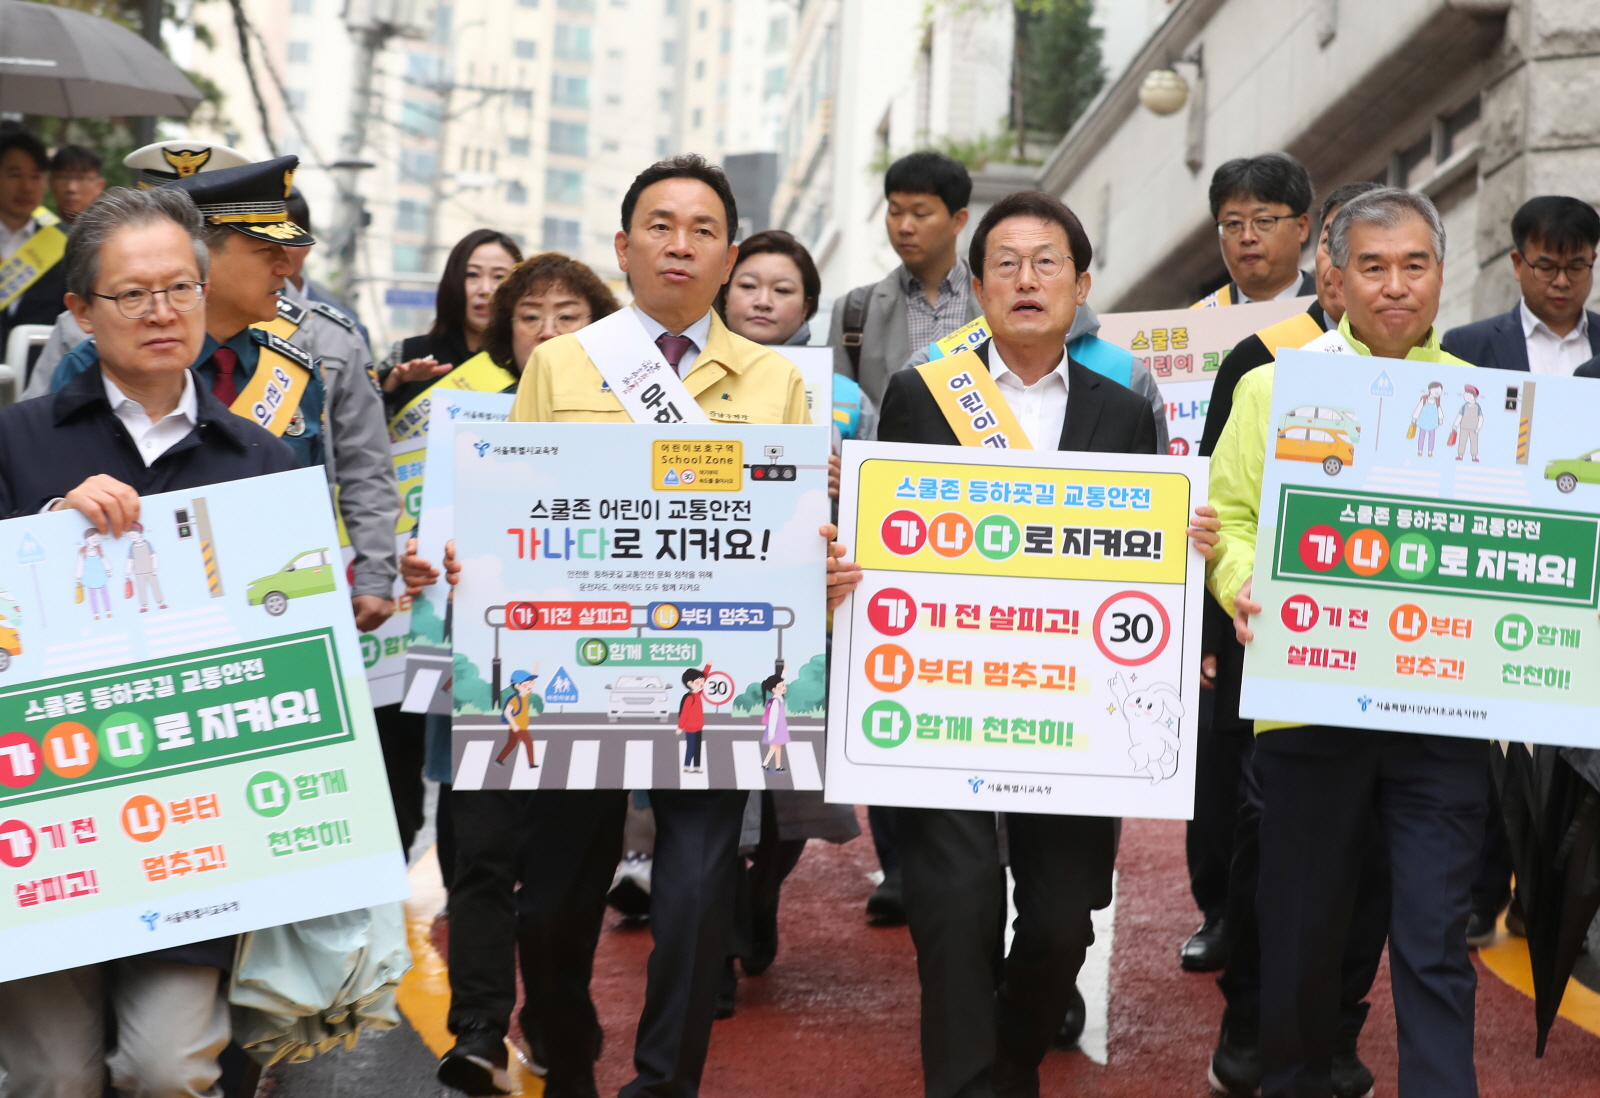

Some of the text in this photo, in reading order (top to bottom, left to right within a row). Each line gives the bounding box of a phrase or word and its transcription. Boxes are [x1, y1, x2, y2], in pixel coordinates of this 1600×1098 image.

[1131, 327, 1189, 351] 스쿨존
[1202, 350, 1234, 371] 교
[256, 369, 290, 426] 어린이
[492, 446, 559, 456] 서울특별시교육청
[661, 443, 734, 453] 어린이보호구역
[661, 455, 734, 464] School Zone
[896, 477, 1151, 509] 스쿨존 등하굣길 교통안전
[530, 499, 752, 522] 스쿨존 어린이 교통안전
[1339, 505, 1541, 541] 스쿨존 등하굣길 교통안전
[507, 527, 771, 561] 가나다로 지켜요!
[1062, 527, 1162, 560] 지켜요!
[625, 570, 655, 579] 교통안전
[698, 570, 713, 579] 위해
[1475, 548, 1576, 588] 지켜요!
[645, 583, 659, 592] 모두
[662, 583, 676, 592] 함께
[578, 608, 628, 625] 살피고
[719, 608, 765, 626] 멈추고
[989, 605, 1080, 635] 살피고!
[1109, 612, 1154, 644] 30
[648, 643, 697, 661] 천천히
[1286, 644, 1357, 672] 살피고!
[983, 660, 1077, 691] 멈추고!
[1395, 654, 1465, 683] 멈추고!
[1501, 662, 1571, 691] 천천히!
[25, 657, 265, 722] 스쿨존 등하굣길 교통안전
[708, 681, 728, 696] 30
[201, 688, 322, 744] 지켜요!
[982, 715, 1074, 747] 천천히!
[987, 783, 1052, 795] 서울특별시교육청
[267, 818, 354, 858] 천천히!
[140, 844, 228, 883] 멈추고!
[13, 868, 101, 909] 살피고!
